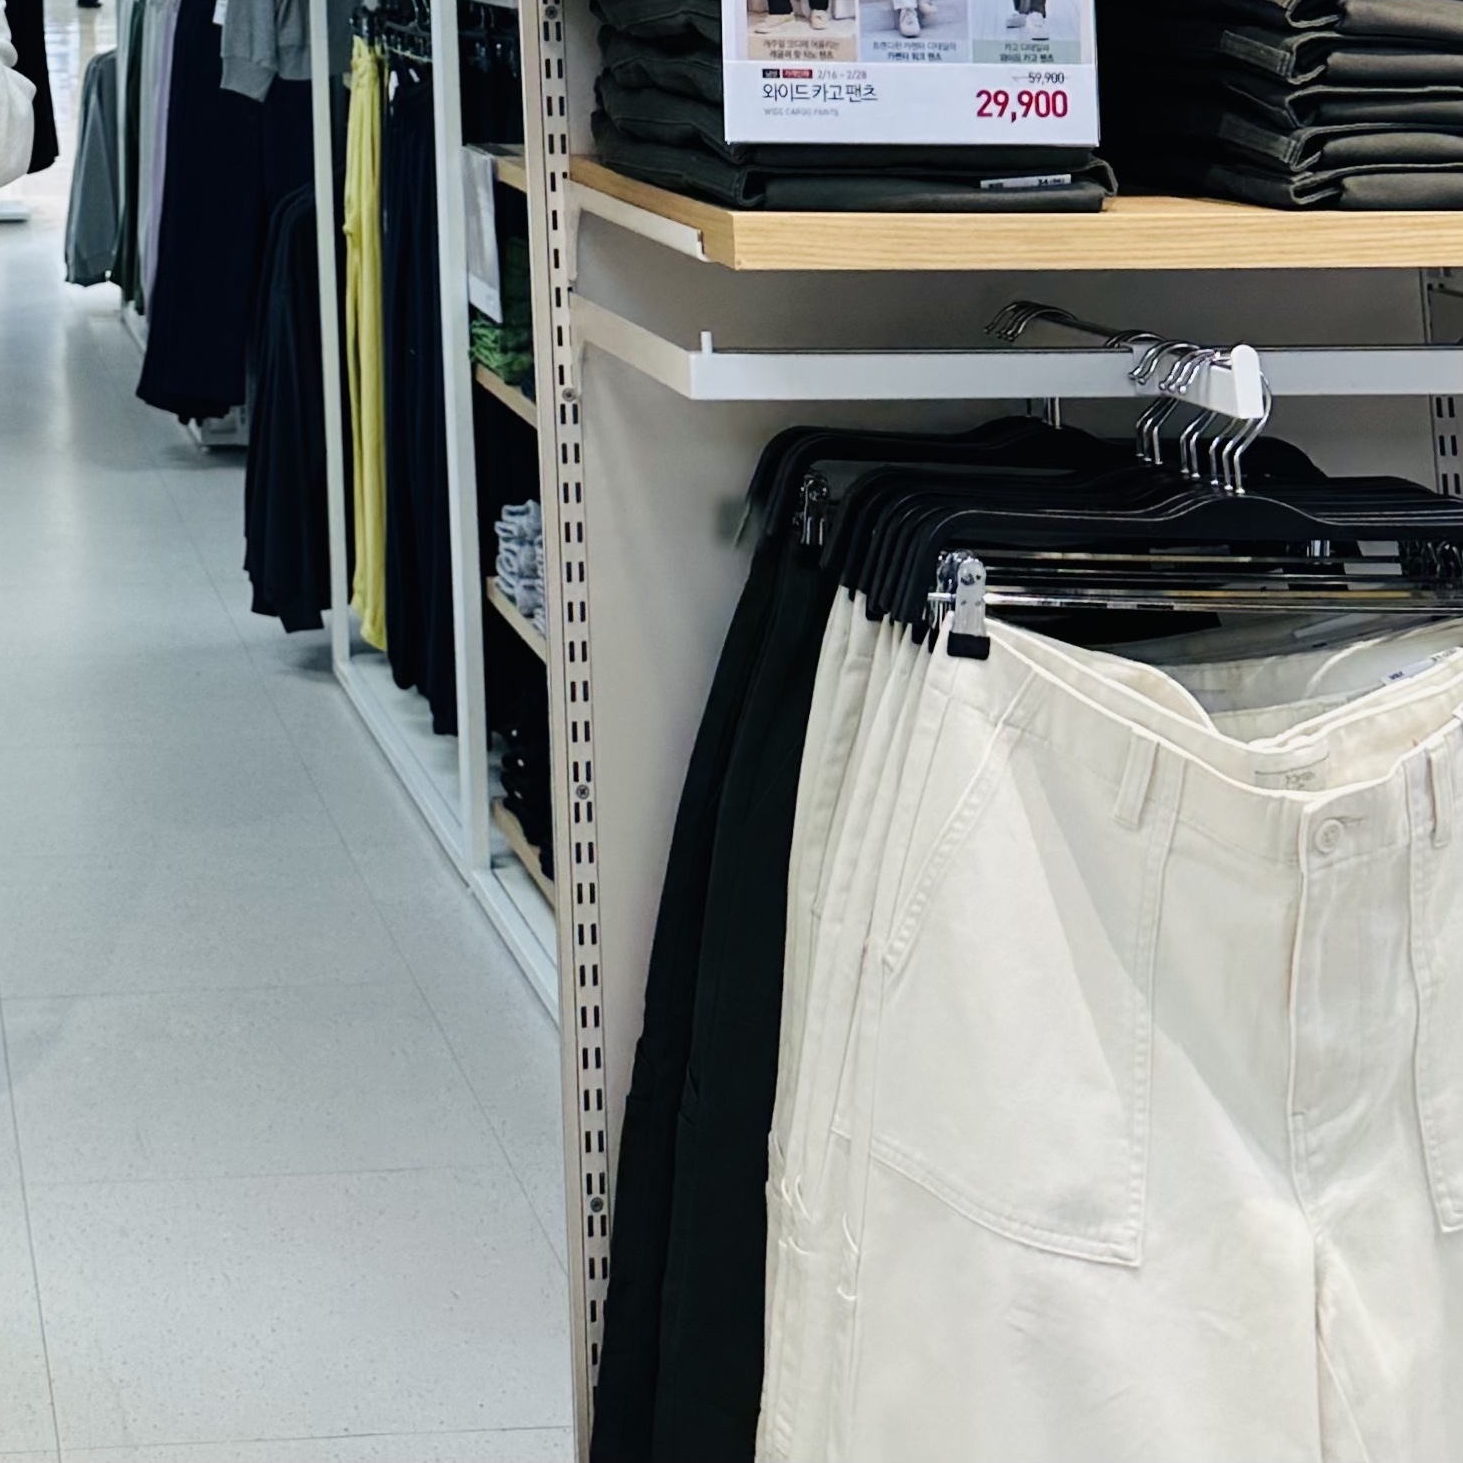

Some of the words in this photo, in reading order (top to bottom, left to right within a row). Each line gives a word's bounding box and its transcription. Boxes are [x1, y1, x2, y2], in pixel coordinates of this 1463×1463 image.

[817, 70, 837, 80] 2/16
[846, 70, 867, 80] 2/28
[1028, 72, 1065, 85] 59,900
[762, 82, 810, 102] 와이드
[811, 82, 844, 102] 카고
[845, 82, 878, 103] 팬츠
[975, 89, 1068, 123] 29,900
